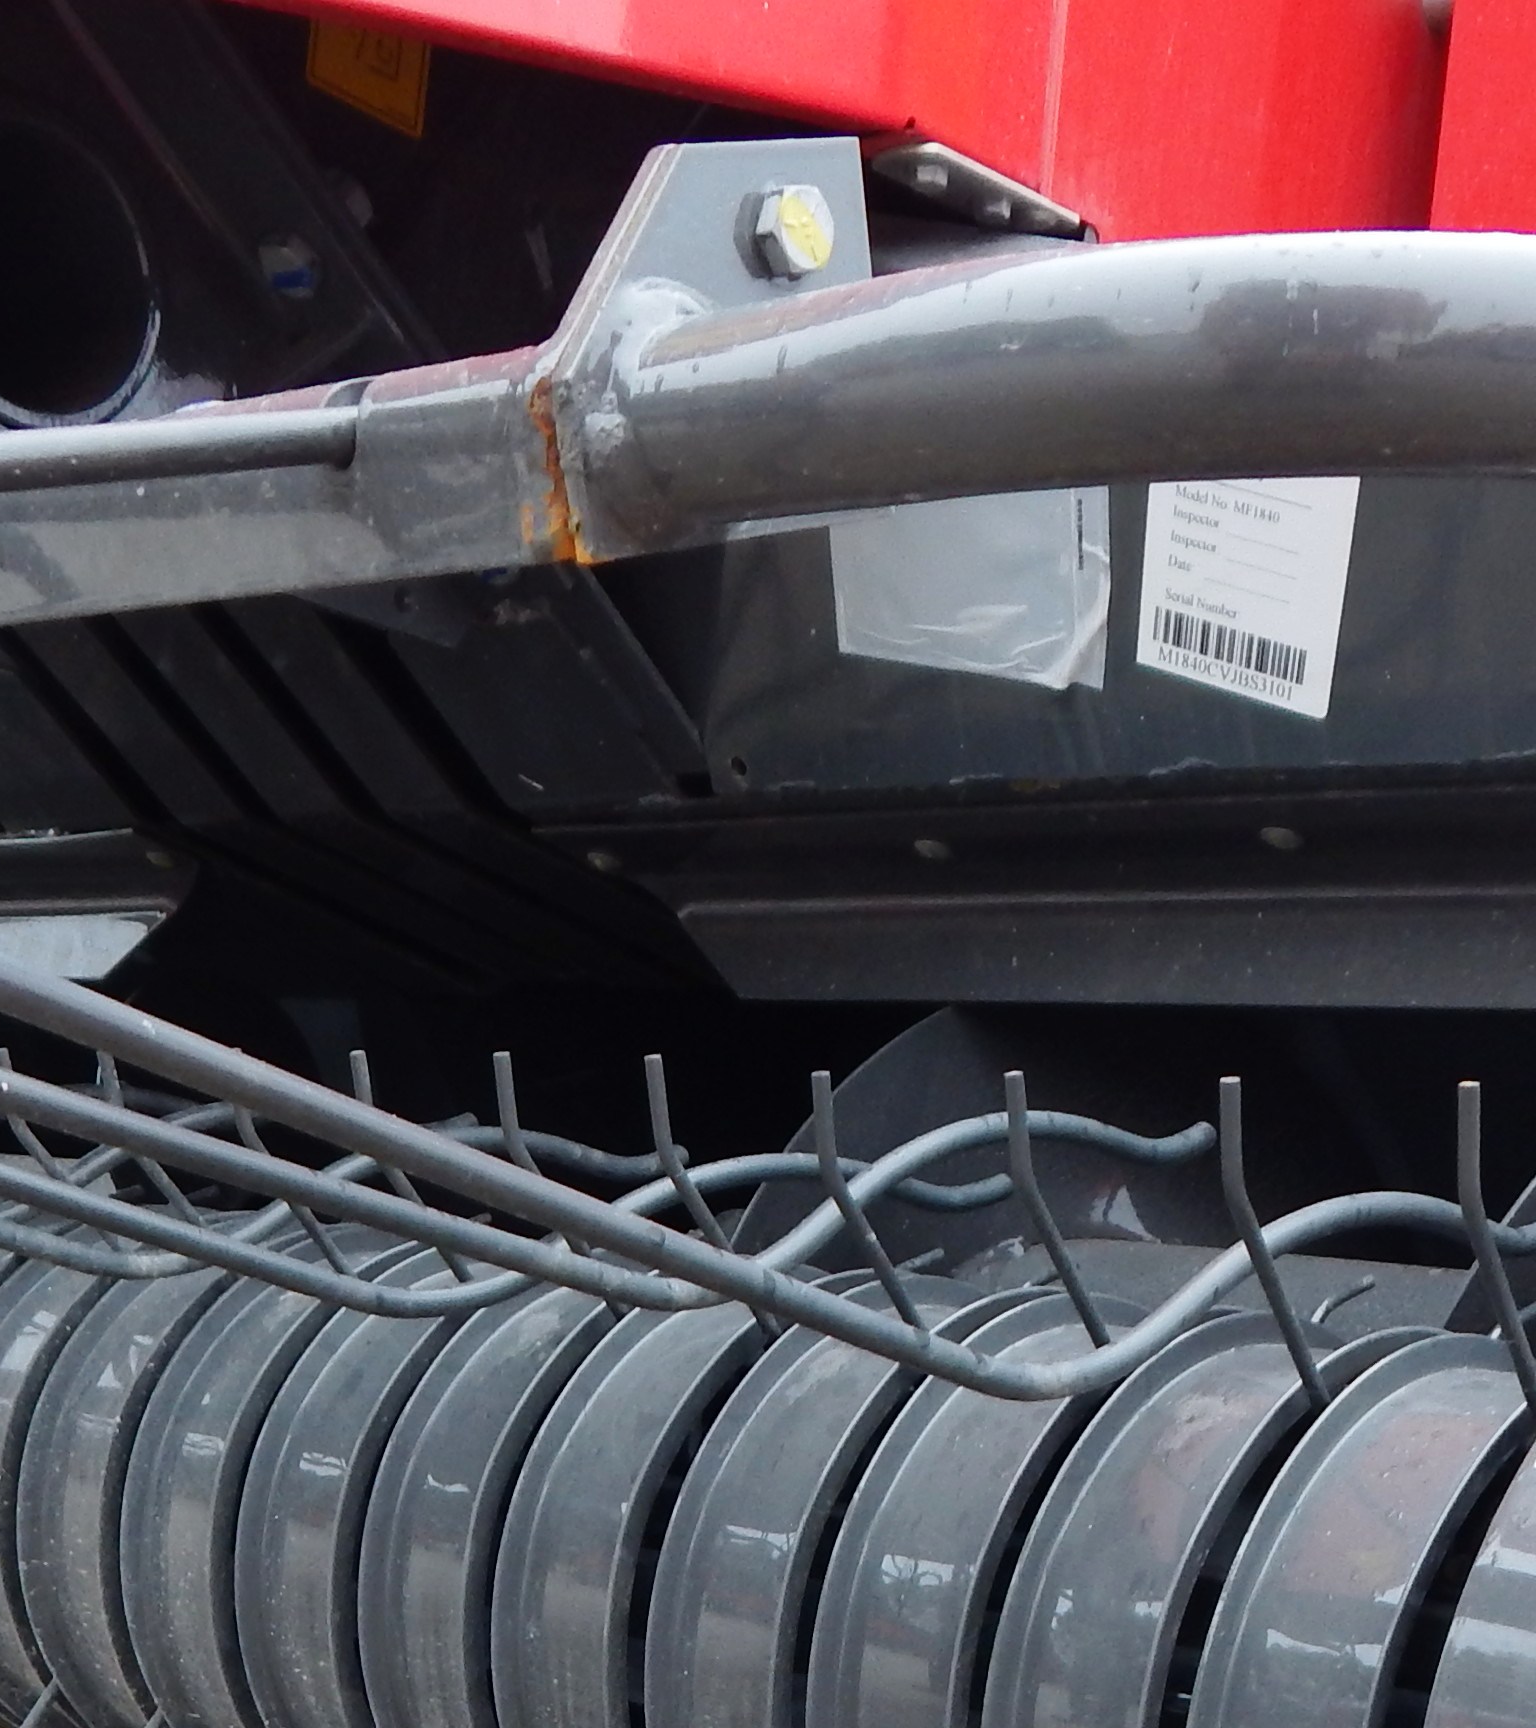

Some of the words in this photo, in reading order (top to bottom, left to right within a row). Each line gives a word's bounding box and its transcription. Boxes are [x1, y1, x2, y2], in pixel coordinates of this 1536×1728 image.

[1175, 483, 1209, 505] Model
[1233, 499, 1281, 524] MF1840
[1173, 504, 1220, 529] Inspector
[1170, 529, 1217, 553] Inspector
[1164, 586, 1194, 607] Serial
